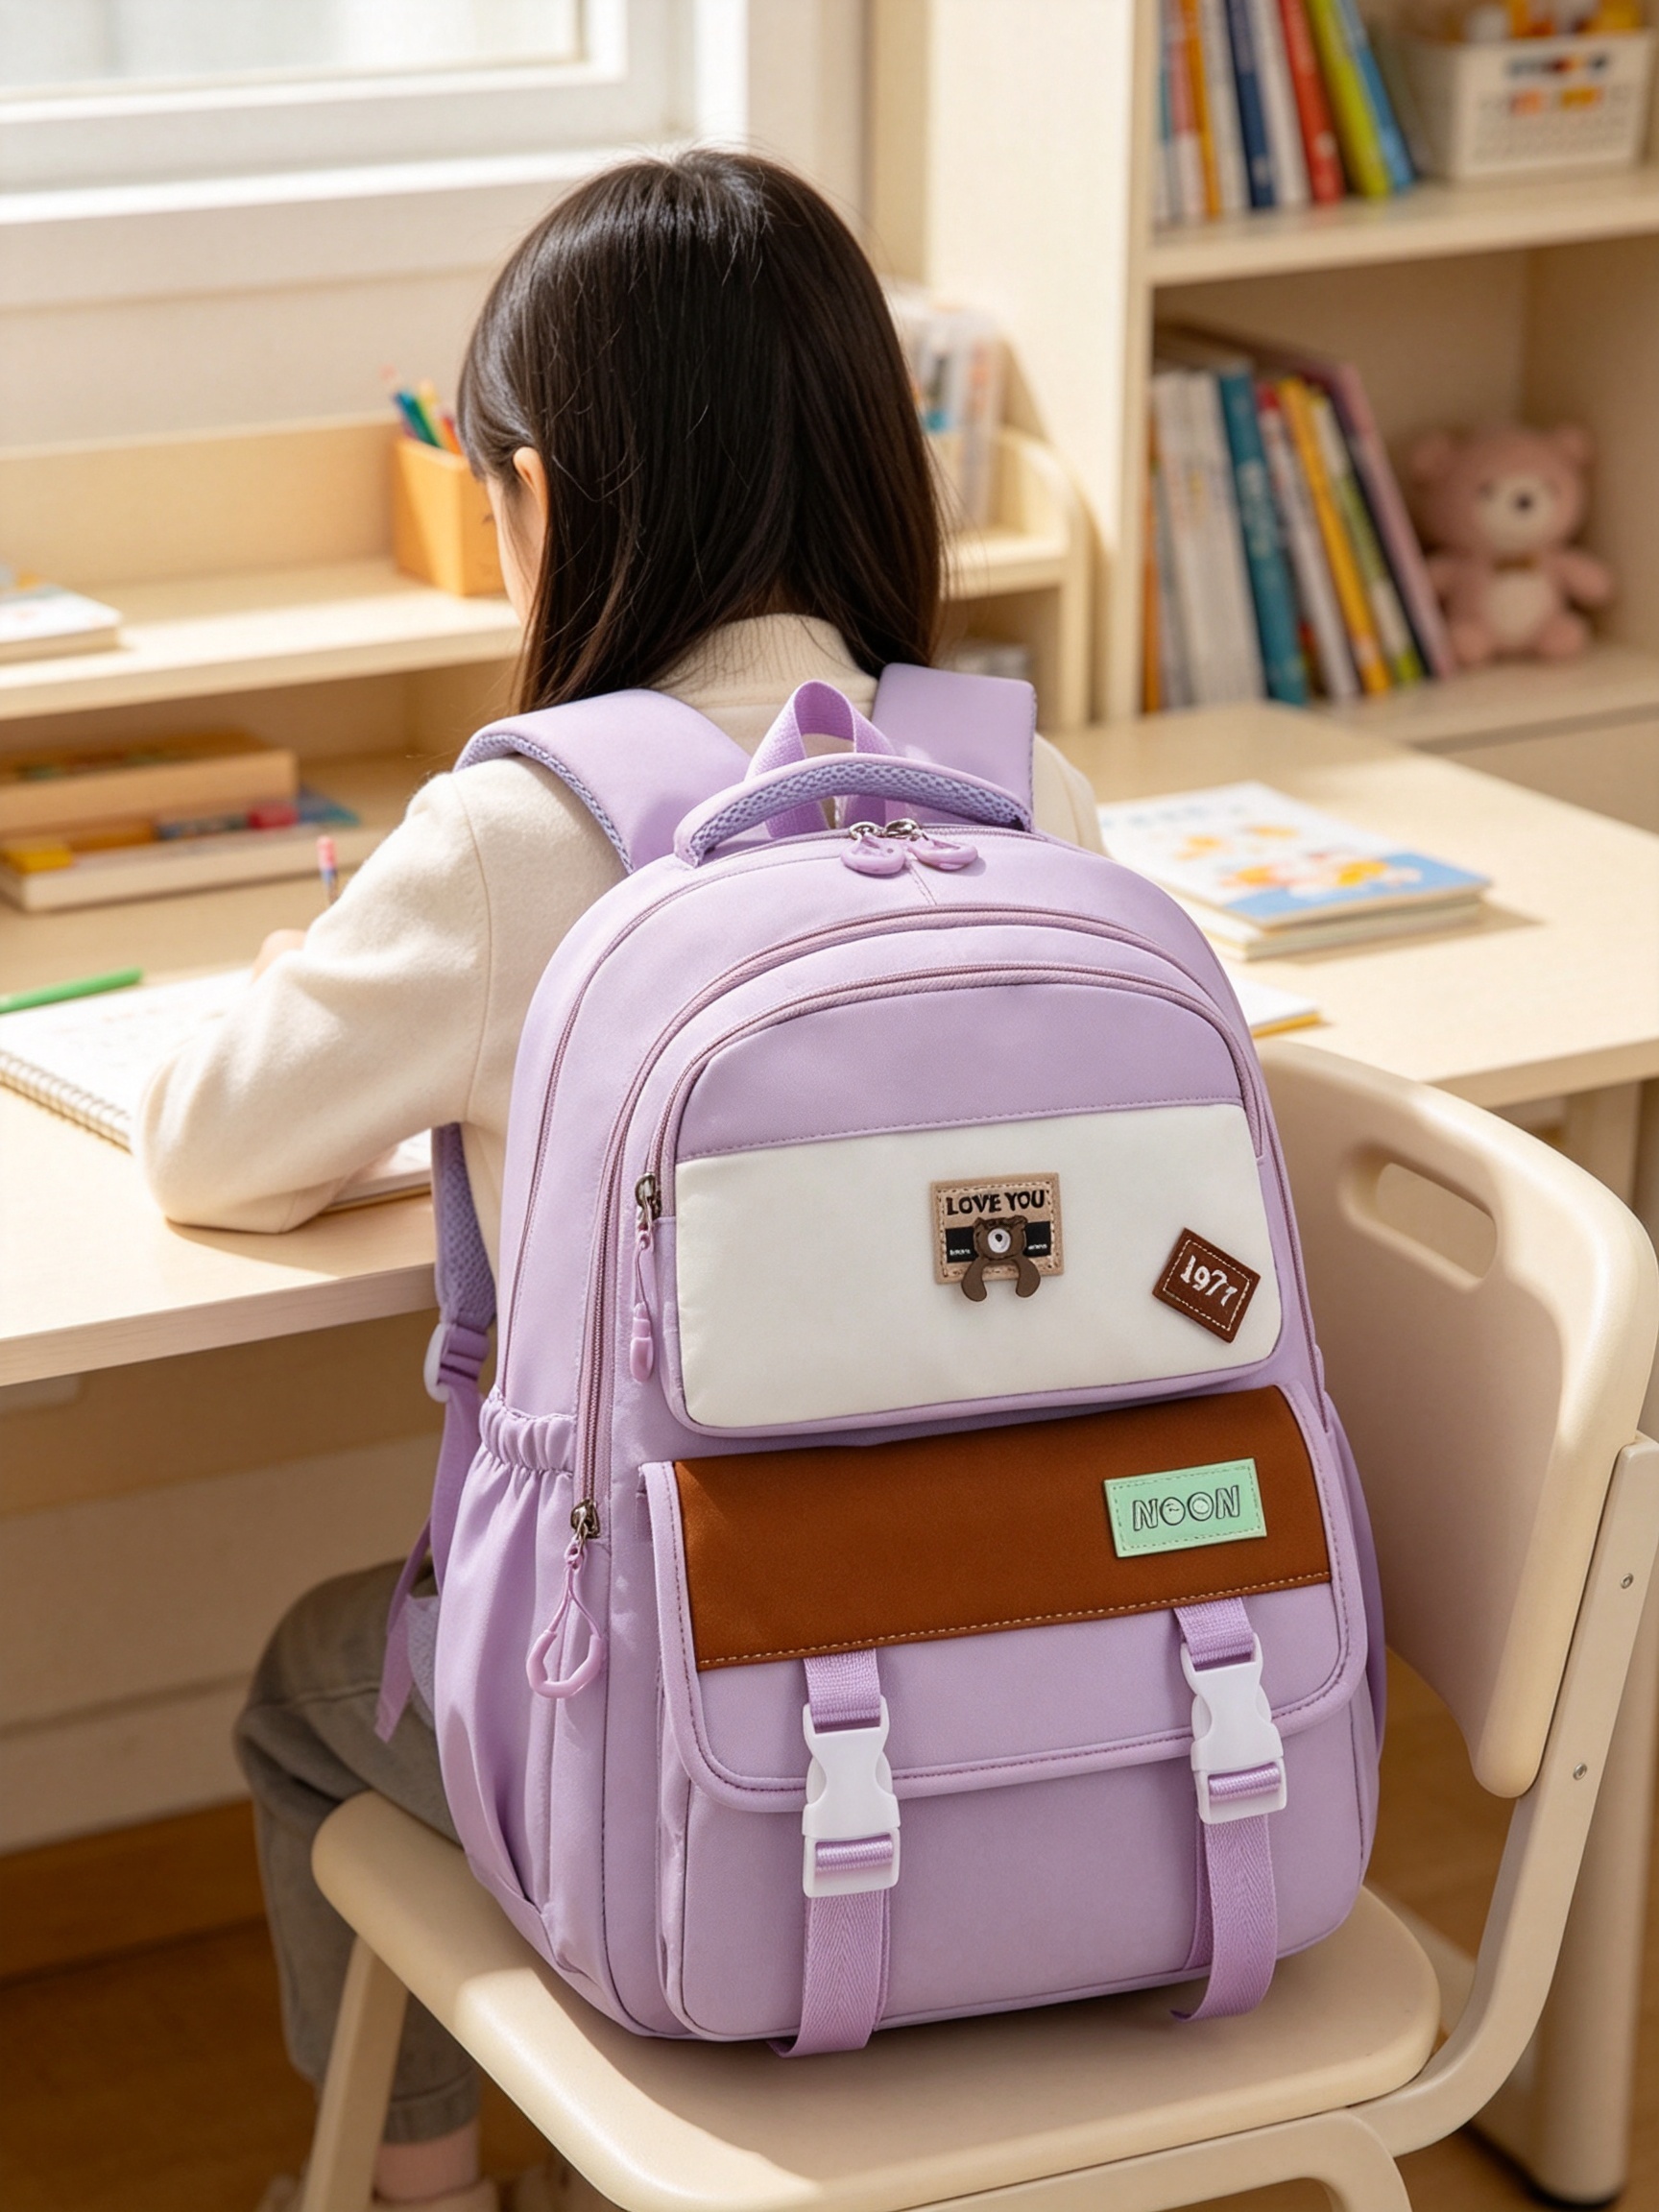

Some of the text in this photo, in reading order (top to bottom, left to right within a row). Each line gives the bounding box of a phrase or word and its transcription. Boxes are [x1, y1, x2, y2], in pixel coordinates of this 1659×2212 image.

[946, 1190, 1045, 1215] LOVE YOU
[1132, 1485, 1240, 1531] NOON
